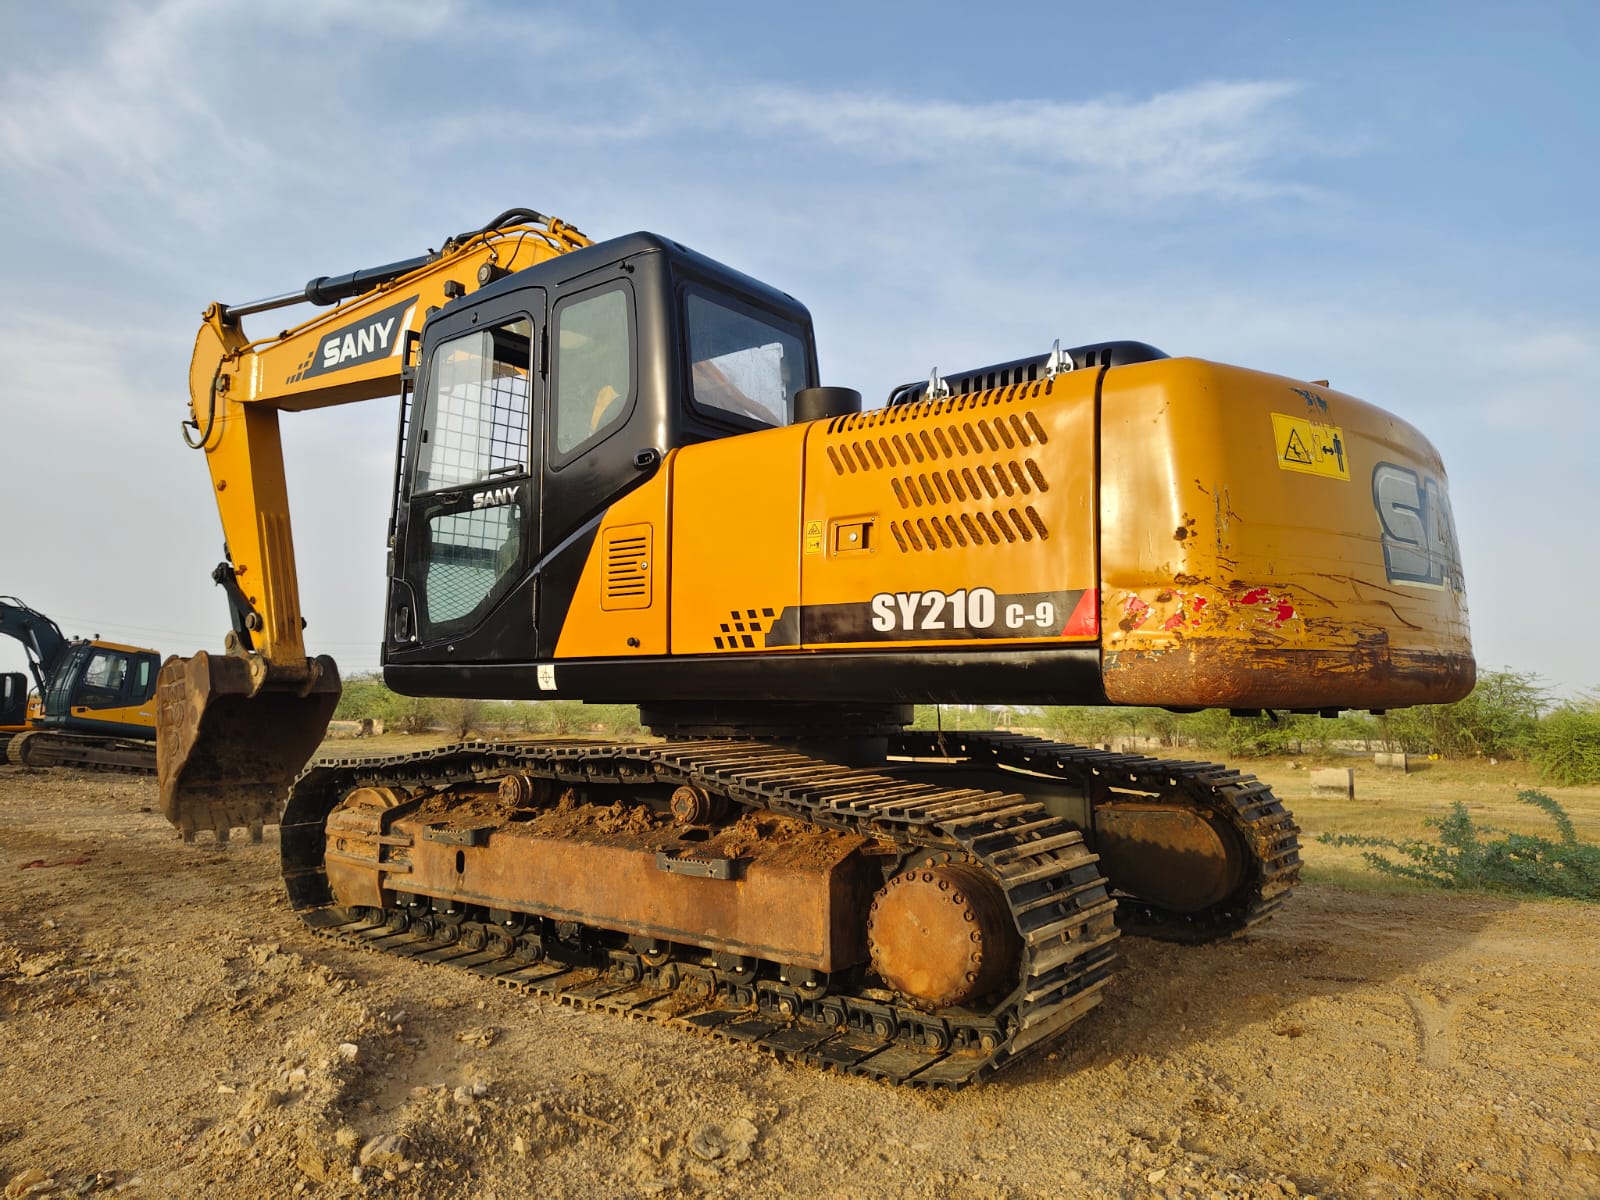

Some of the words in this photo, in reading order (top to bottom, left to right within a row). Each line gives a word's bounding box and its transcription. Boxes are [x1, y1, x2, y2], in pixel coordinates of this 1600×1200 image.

[323, 317, 395, 368] SANY
[473, 486, 520, 508] SANY
[872, 588, 996, 632] SY210
